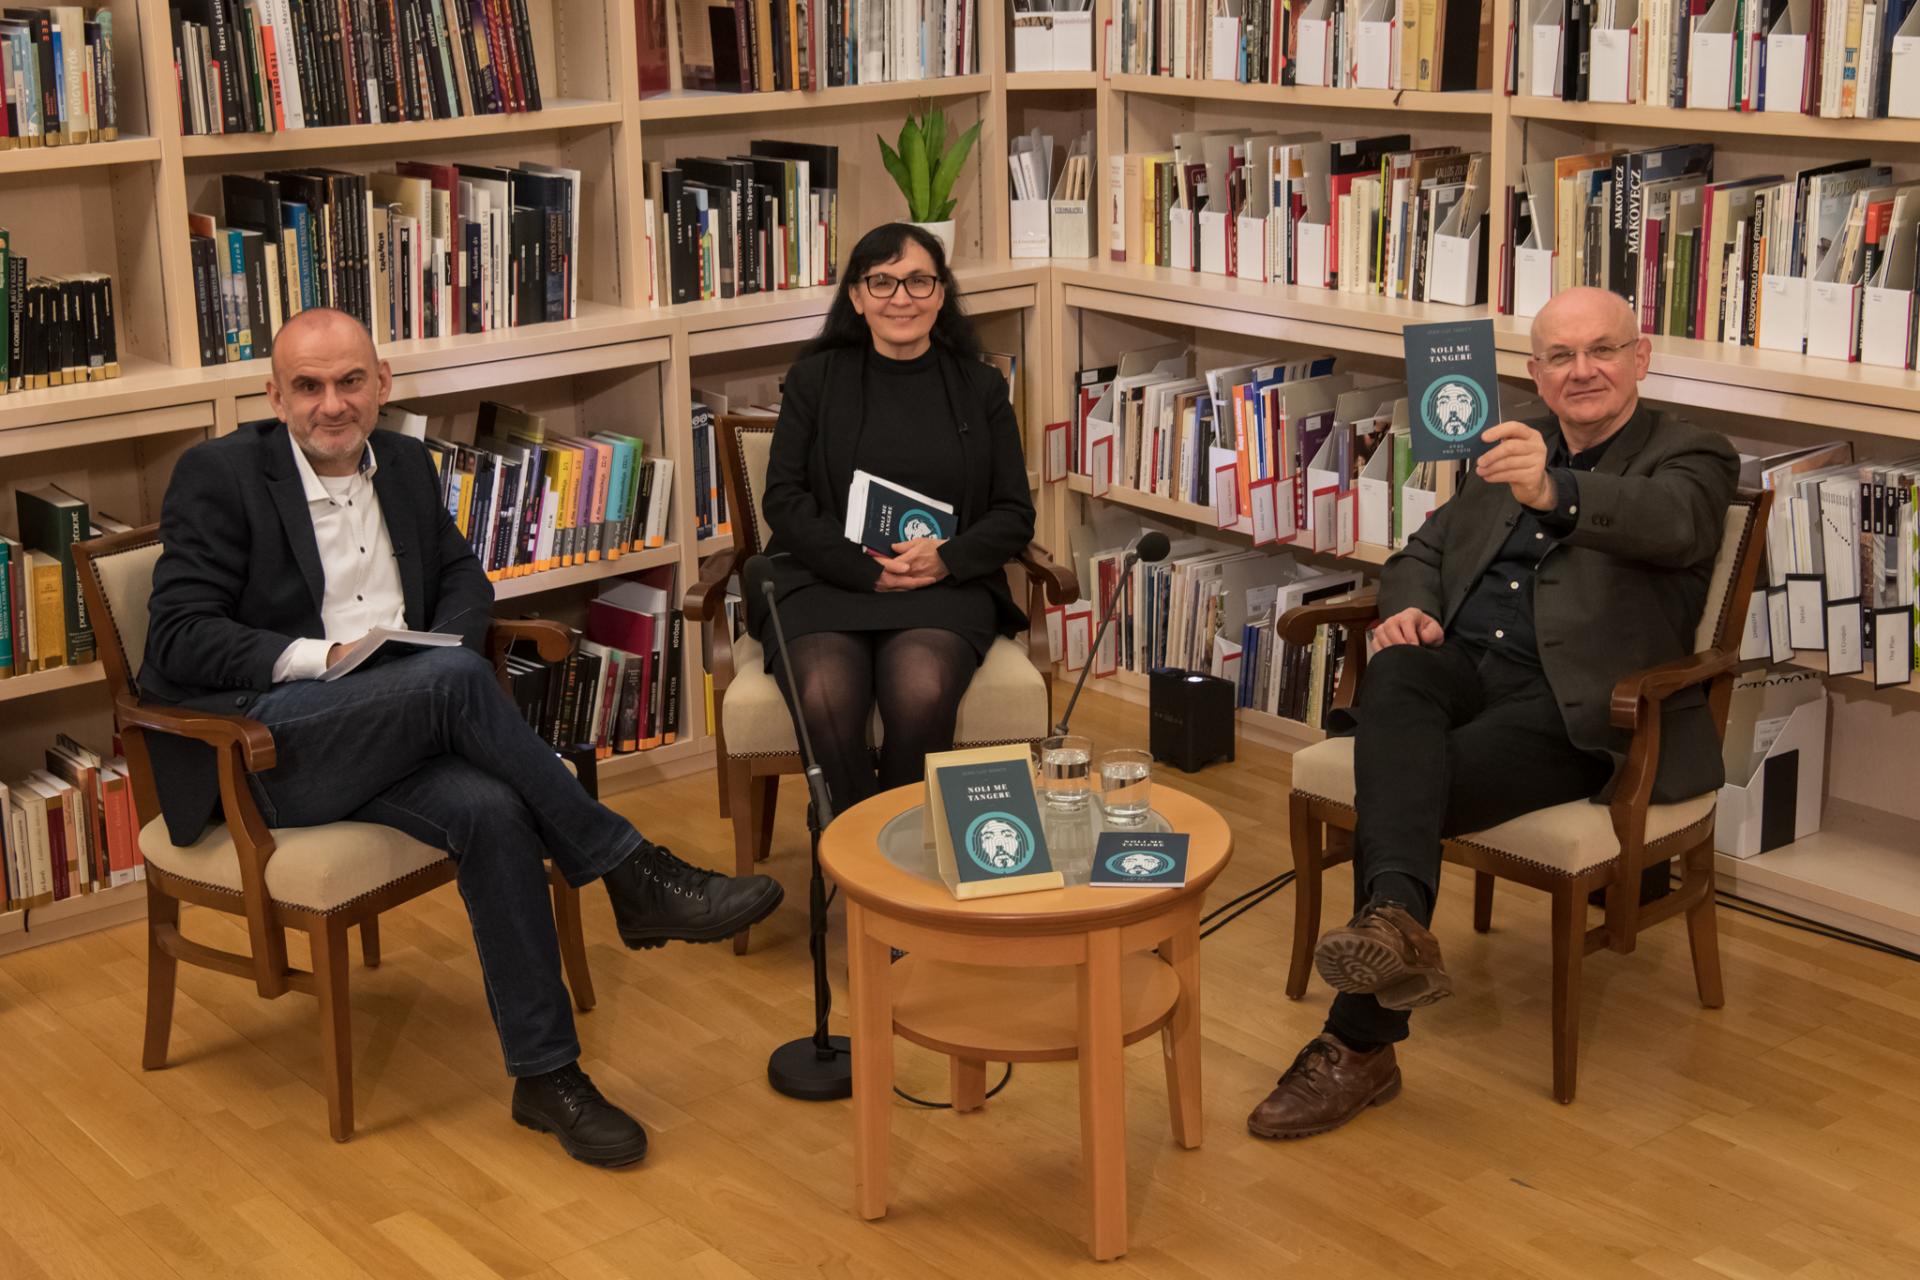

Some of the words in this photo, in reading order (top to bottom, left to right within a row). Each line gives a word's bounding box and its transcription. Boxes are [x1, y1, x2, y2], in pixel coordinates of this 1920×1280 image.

[217, 27, 227, 51] Haris
[746, 178, 754, 203] György
[1614, 165, 1624, 229] MAKOVECZ
[1629, 169, 1642, 254] MAKOVECZ
[1753, 199, 1764, 241] ÉPÍTÉSZETE
[377, 232, 387, 273] TRIANON
[1752, 242, 1761, 271] MAGYAR
[1749, 273, 1759, 331] SZÁZADFORDULÓ
[1429, 353, 1473, 363] TANGERE
[1430, 346, 1454, 354] NOLI
[1456, 345, 1470, 353] ME
[885, 505, 893, 536] TANGERE
[669, 676, 677, 695] PÉTER
[668, 698, 676, 724] KORNISS
[552, 720, 561, 748] ANDER
[967, 785, 991, 794] NOLI
[993, 783, 1008, 792] ME
[967, 790, 1011, 802] TANGERE
